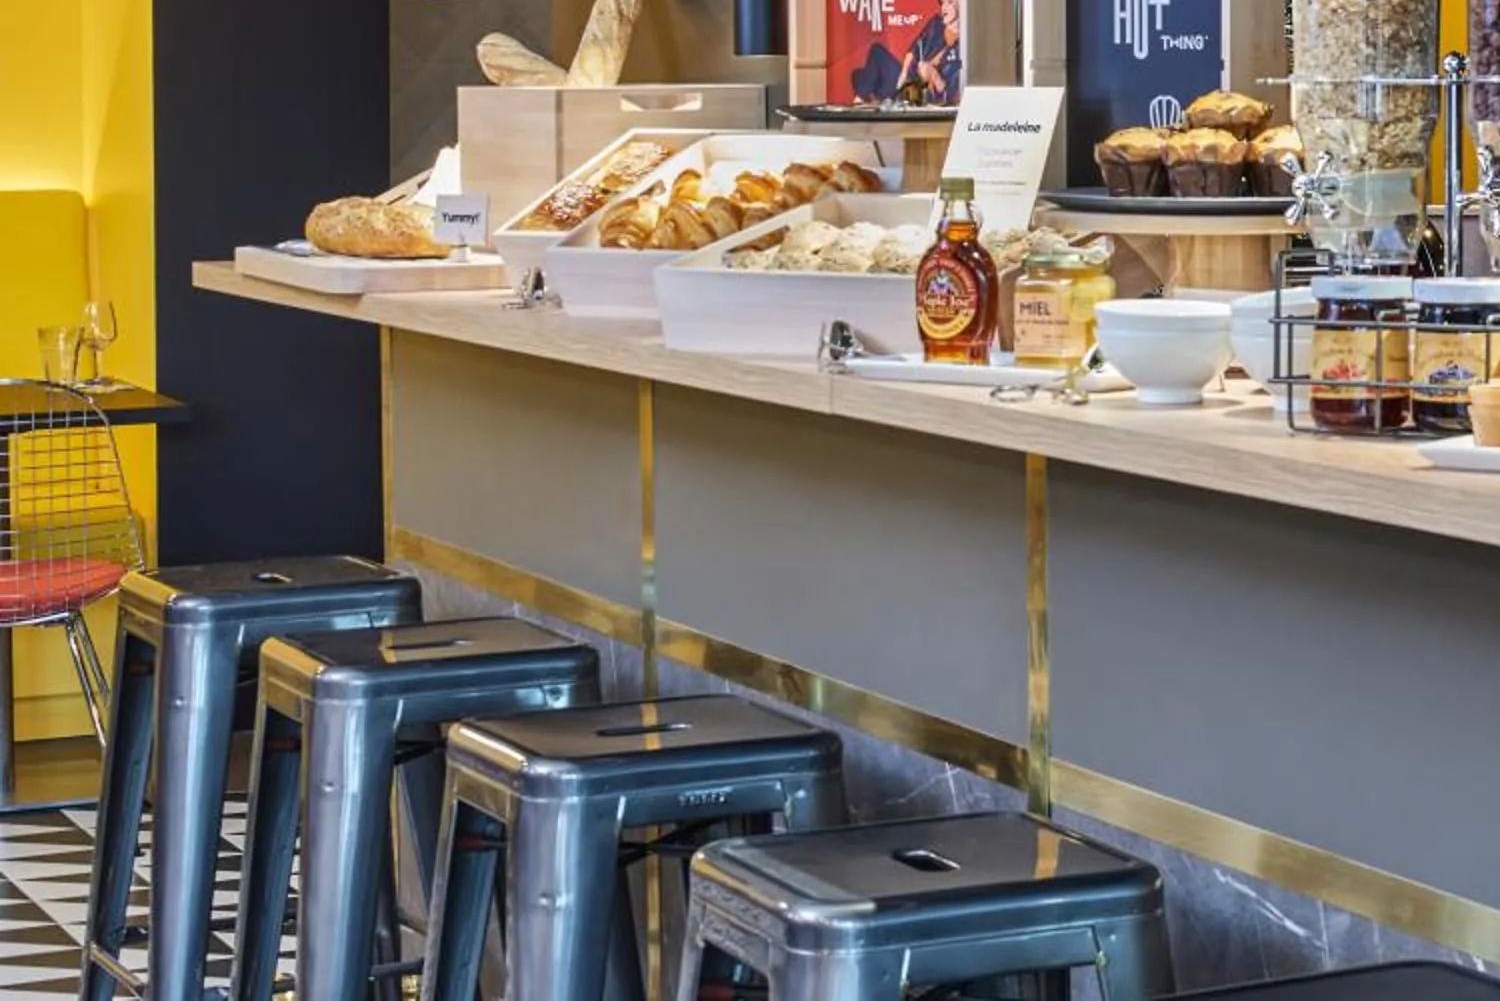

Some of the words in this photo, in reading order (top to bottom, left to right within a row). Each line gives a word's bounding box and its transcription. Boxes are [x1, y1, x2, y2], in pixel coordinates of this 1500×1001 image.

[1160, 35, 1204, 50] THING
[967, 121, 981, 132] La
[981, 119, 1041, 134] madeleine
[1019, 301, 1052, 316] MIEL
